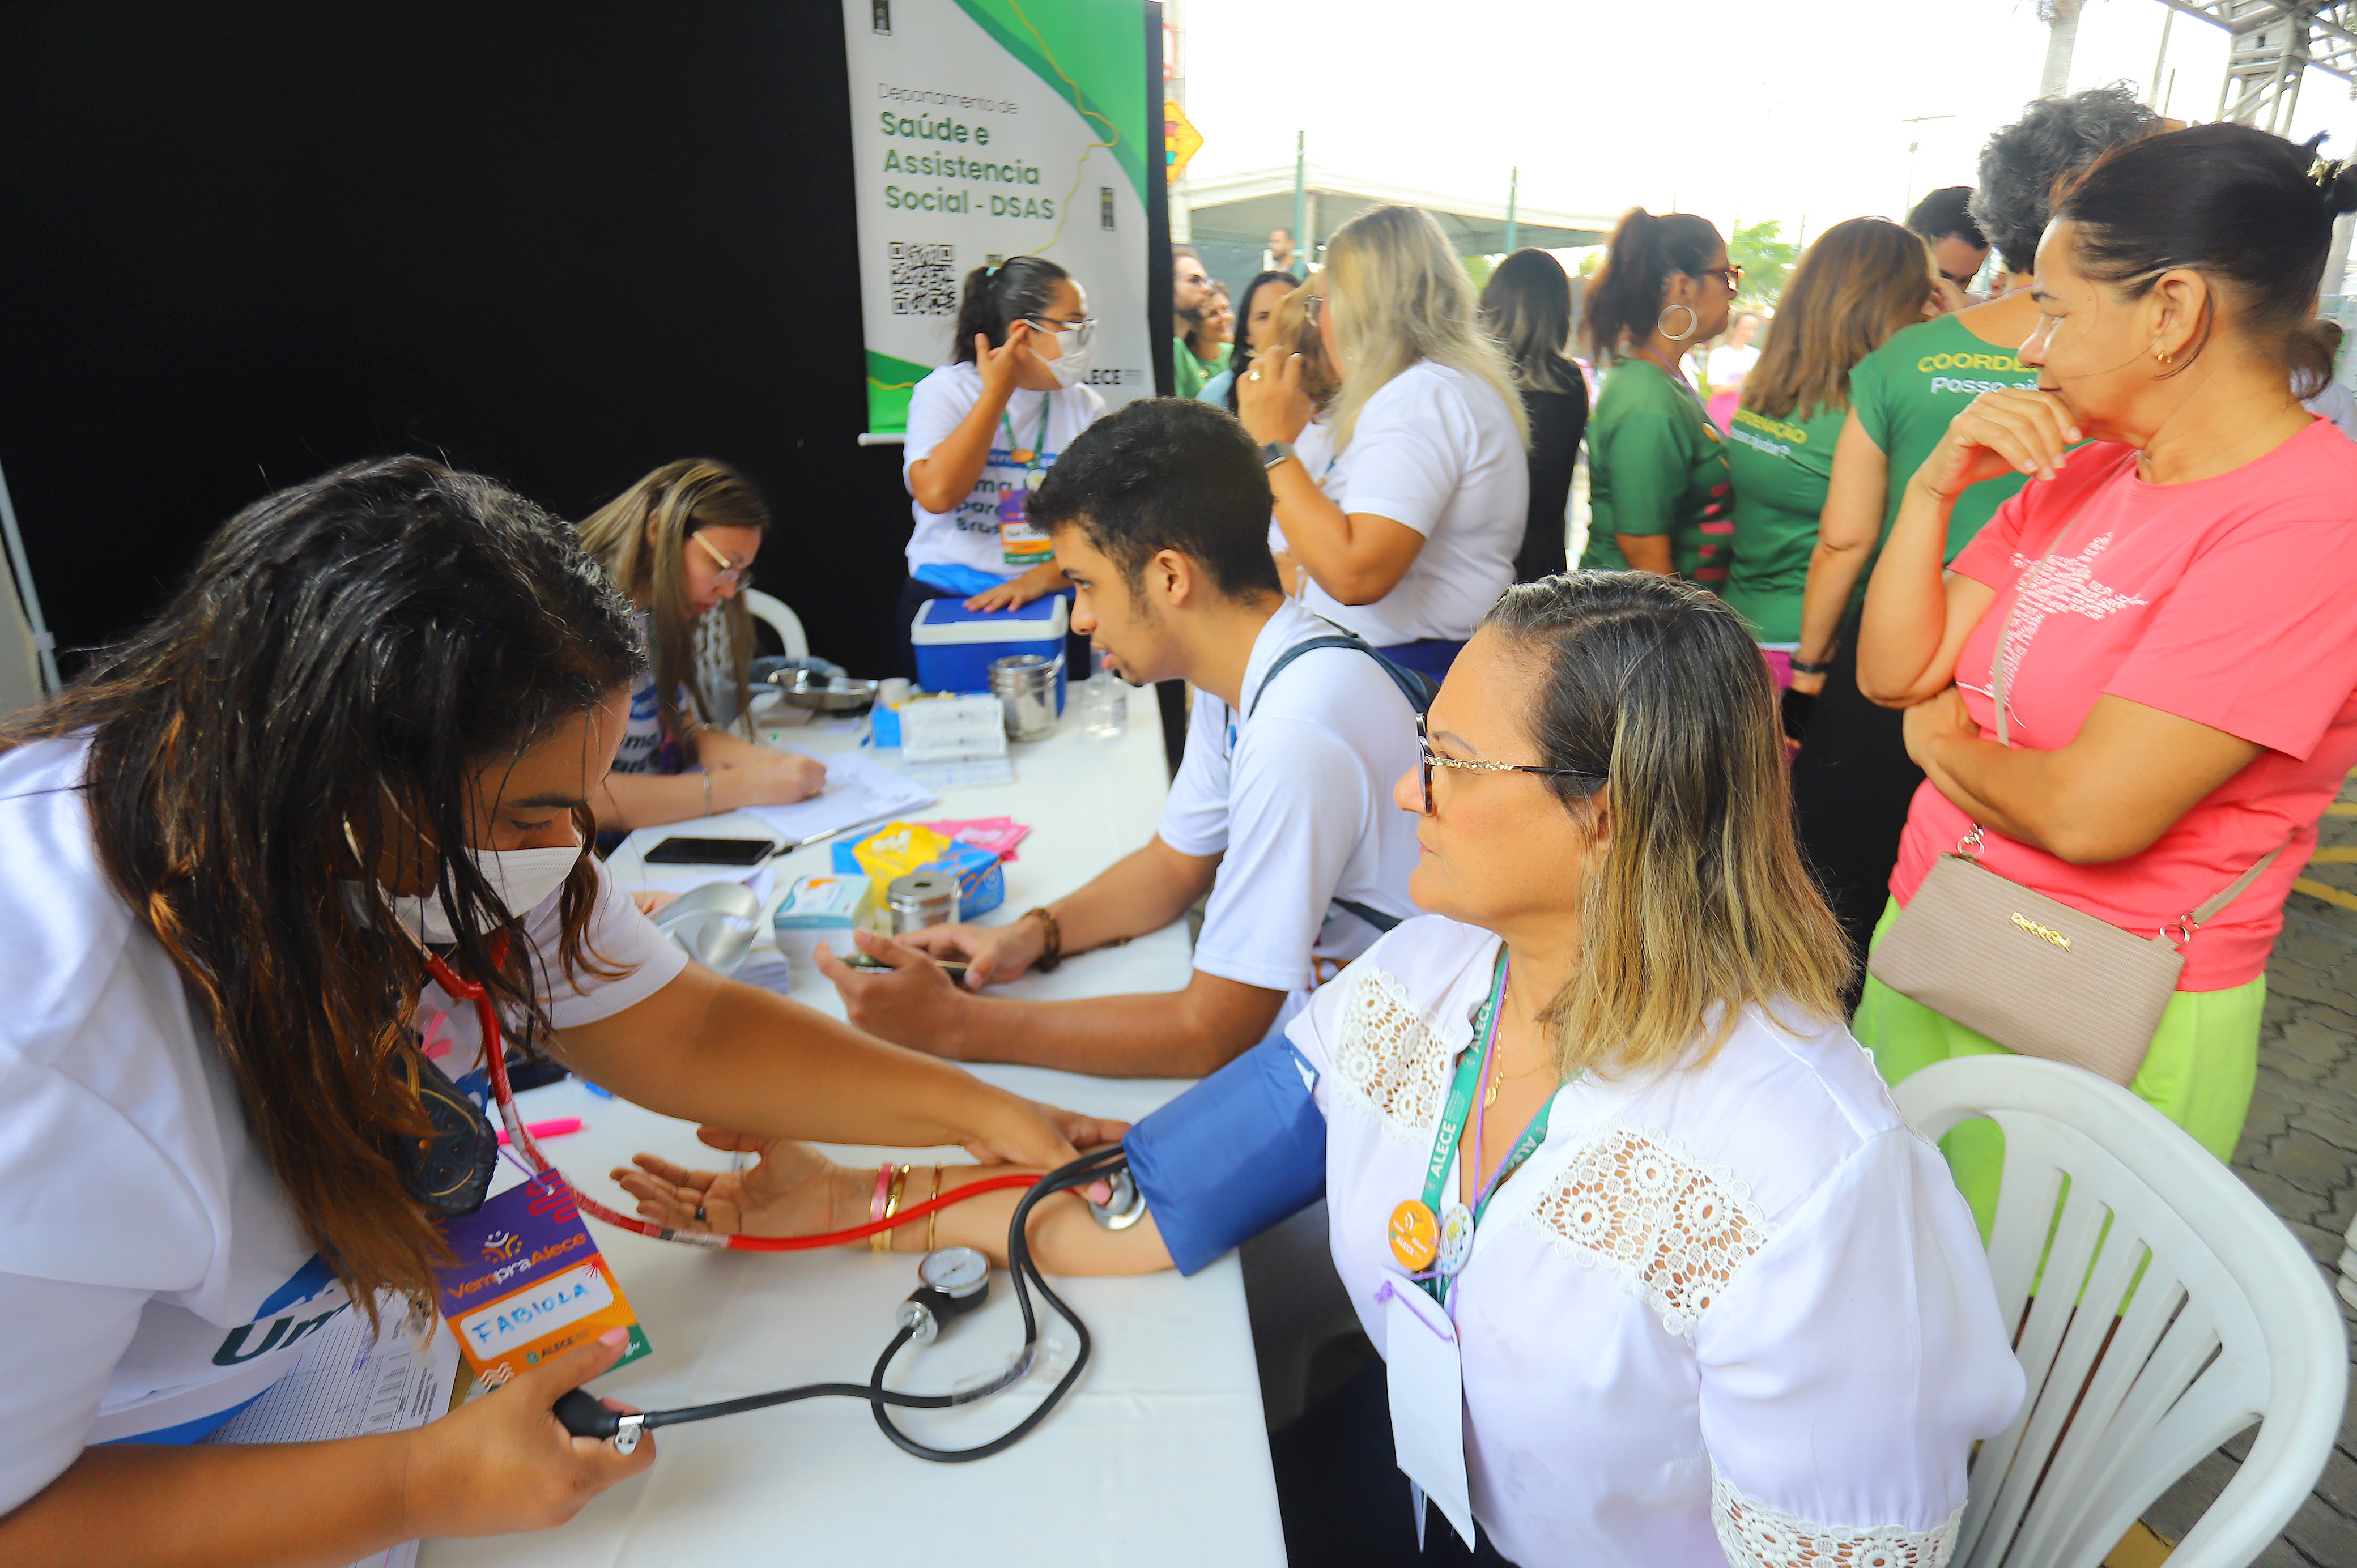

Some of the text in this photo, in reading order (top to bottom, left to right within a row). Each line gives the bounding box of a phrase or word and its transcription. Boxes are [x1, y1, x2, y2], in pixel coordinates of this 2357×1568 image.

[877, 82, 1019, 114] Departamento de
[881, 112, 990, 146] Saúde e
[883, 148, 1040, 185] Assistencia
[886, 185, 968, 214] Social
[991, 194, 1054, 220] DSAS
[1470, 1000, 1493, 1055] ALECE
[1429, 1119, 1458, 1179] ALECE
[471, 1282, 591, 1345] FABIOLA
